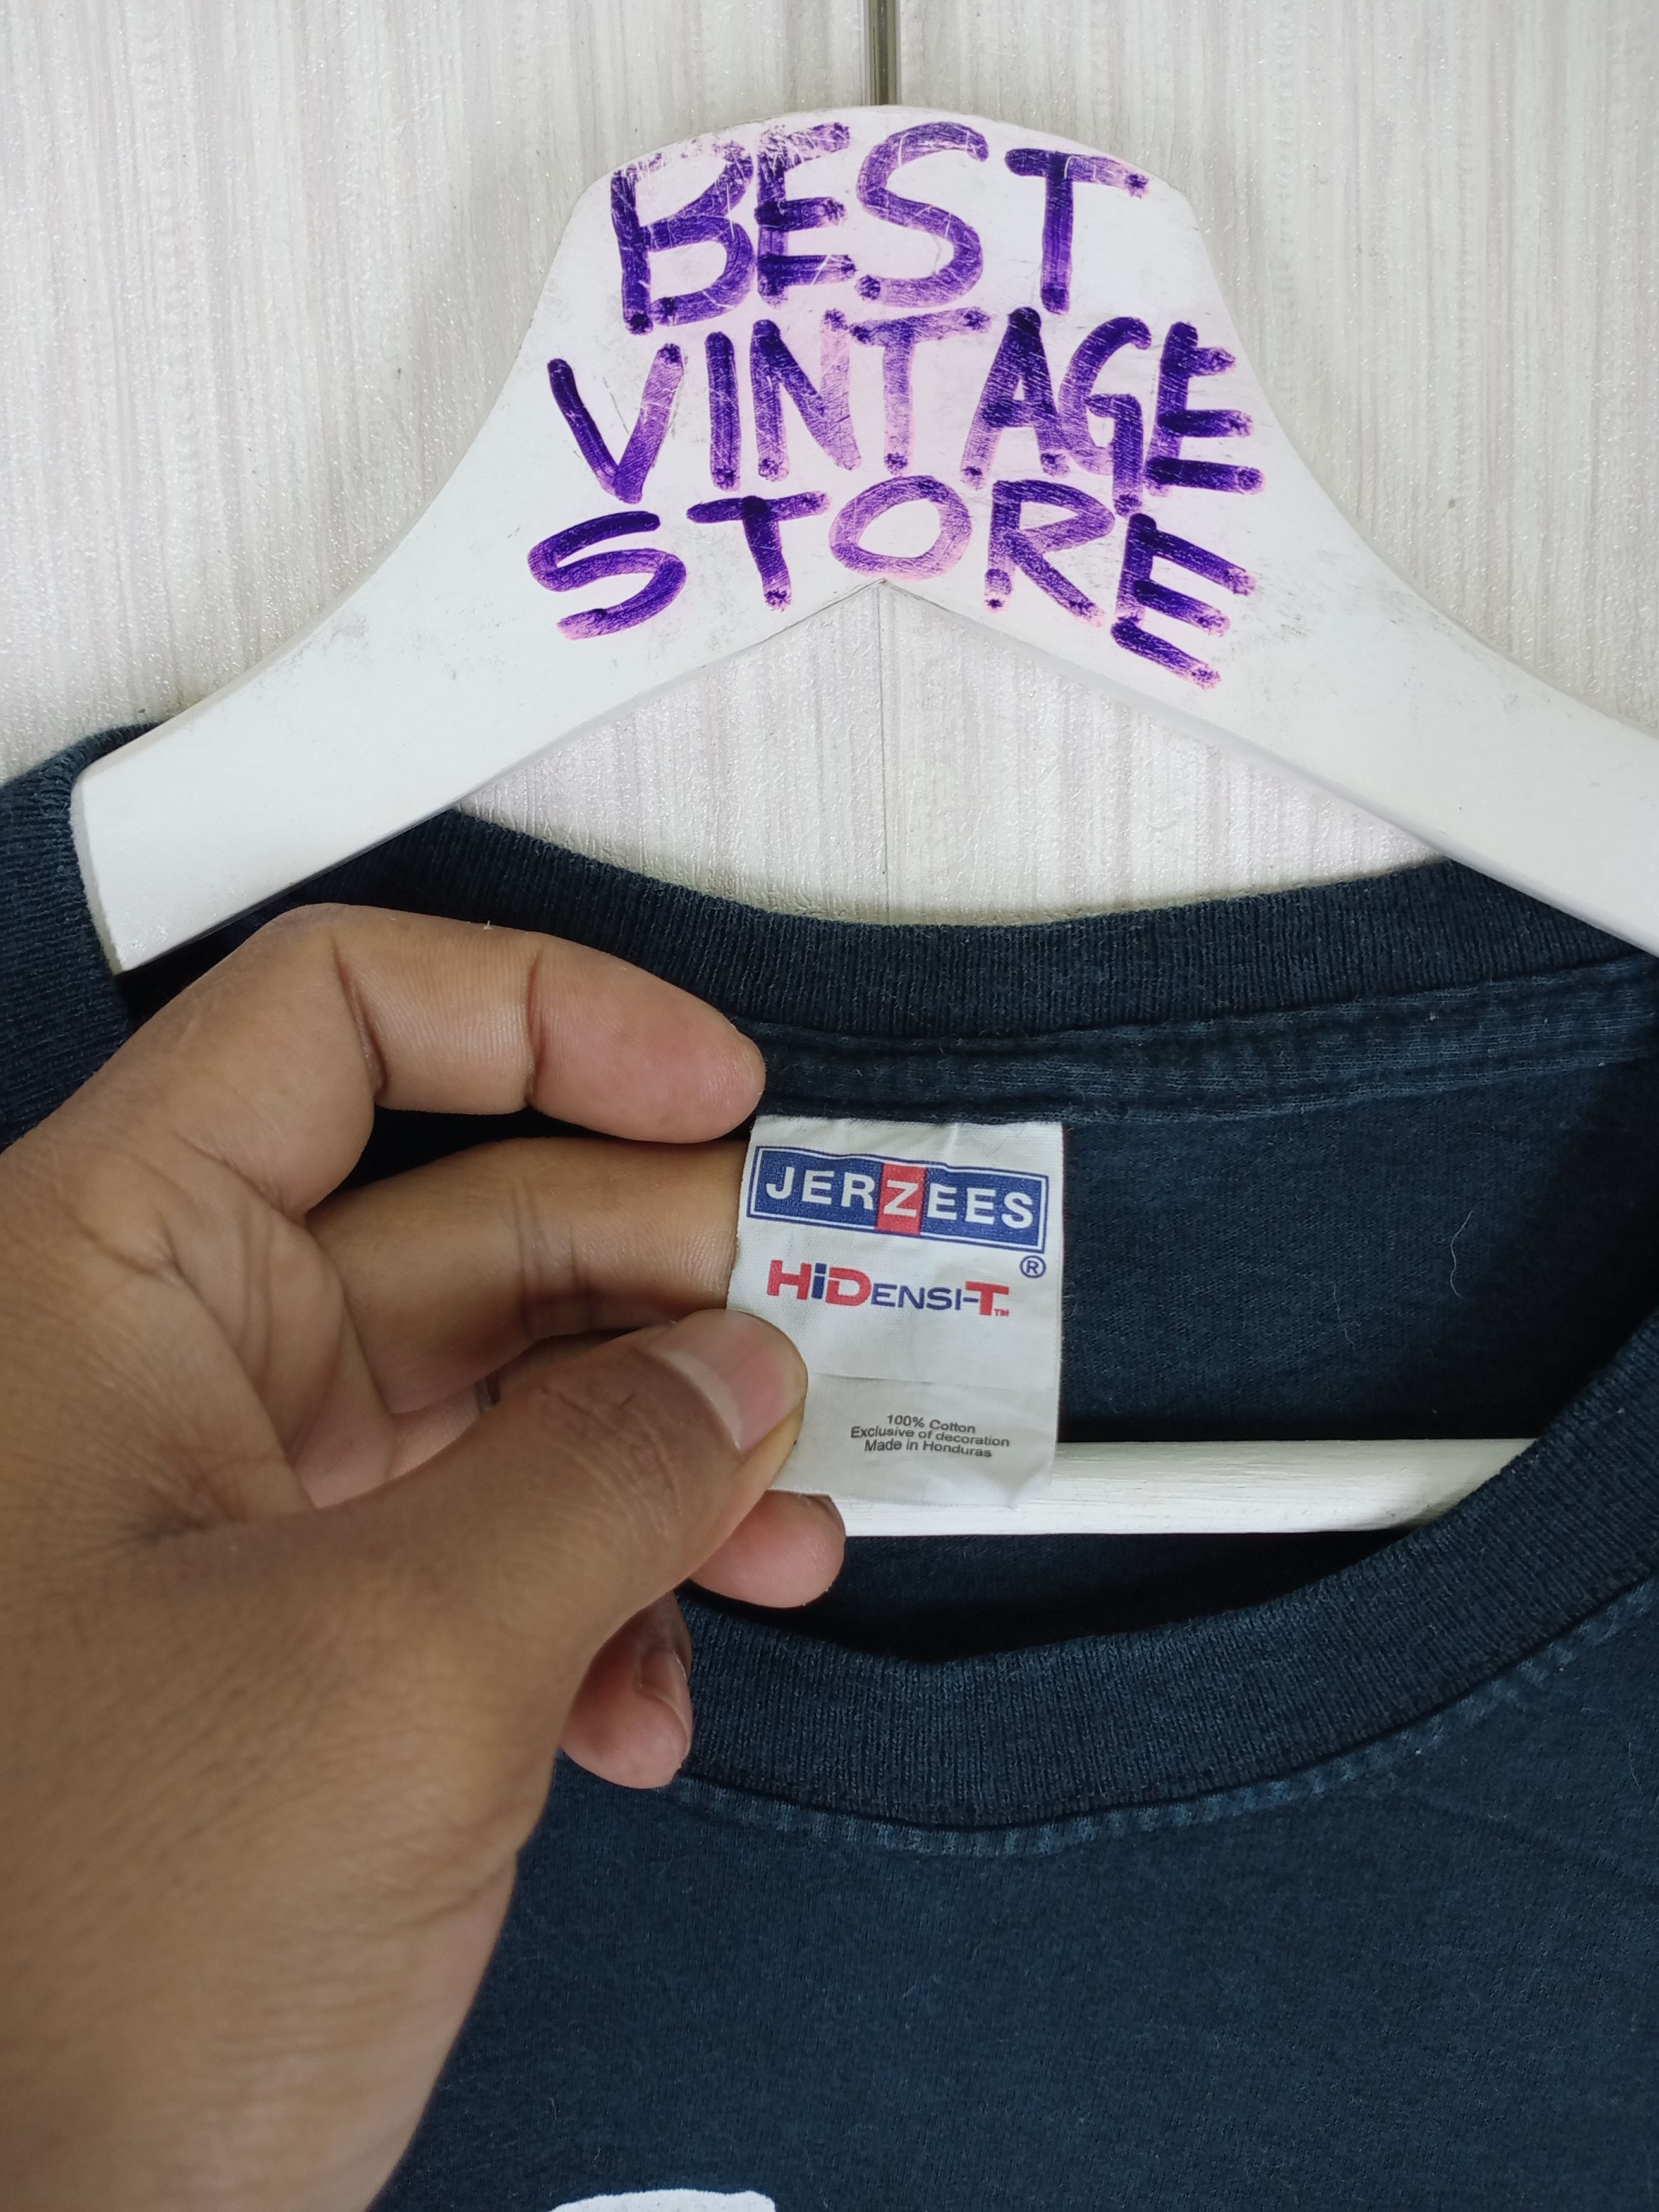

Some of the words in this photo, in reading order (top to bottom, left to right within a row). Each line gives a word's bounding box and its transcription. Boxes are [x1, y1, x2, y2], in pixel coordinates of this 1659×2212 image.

[610, 121, 1150, 335] BEST
[547, 307, 1263, 517] VINTAGE
[527, 475, 1256, 689] STORE
[765, 1166, 1035, 1230] JERZEES
[850, 1425, 915, 1438] Exclusive
[918, 1429, 932, 1439] of
[935, 1431, 1010, 1447] decoration
[864, 1438, 902, 1452] Made
[906, 1438, 918, 1450] in
[922, 1442, 992, 1457] Honduras
[887, 1414, 925, 1428] 100%
[929, 1419, 976, 1434] Cotton
